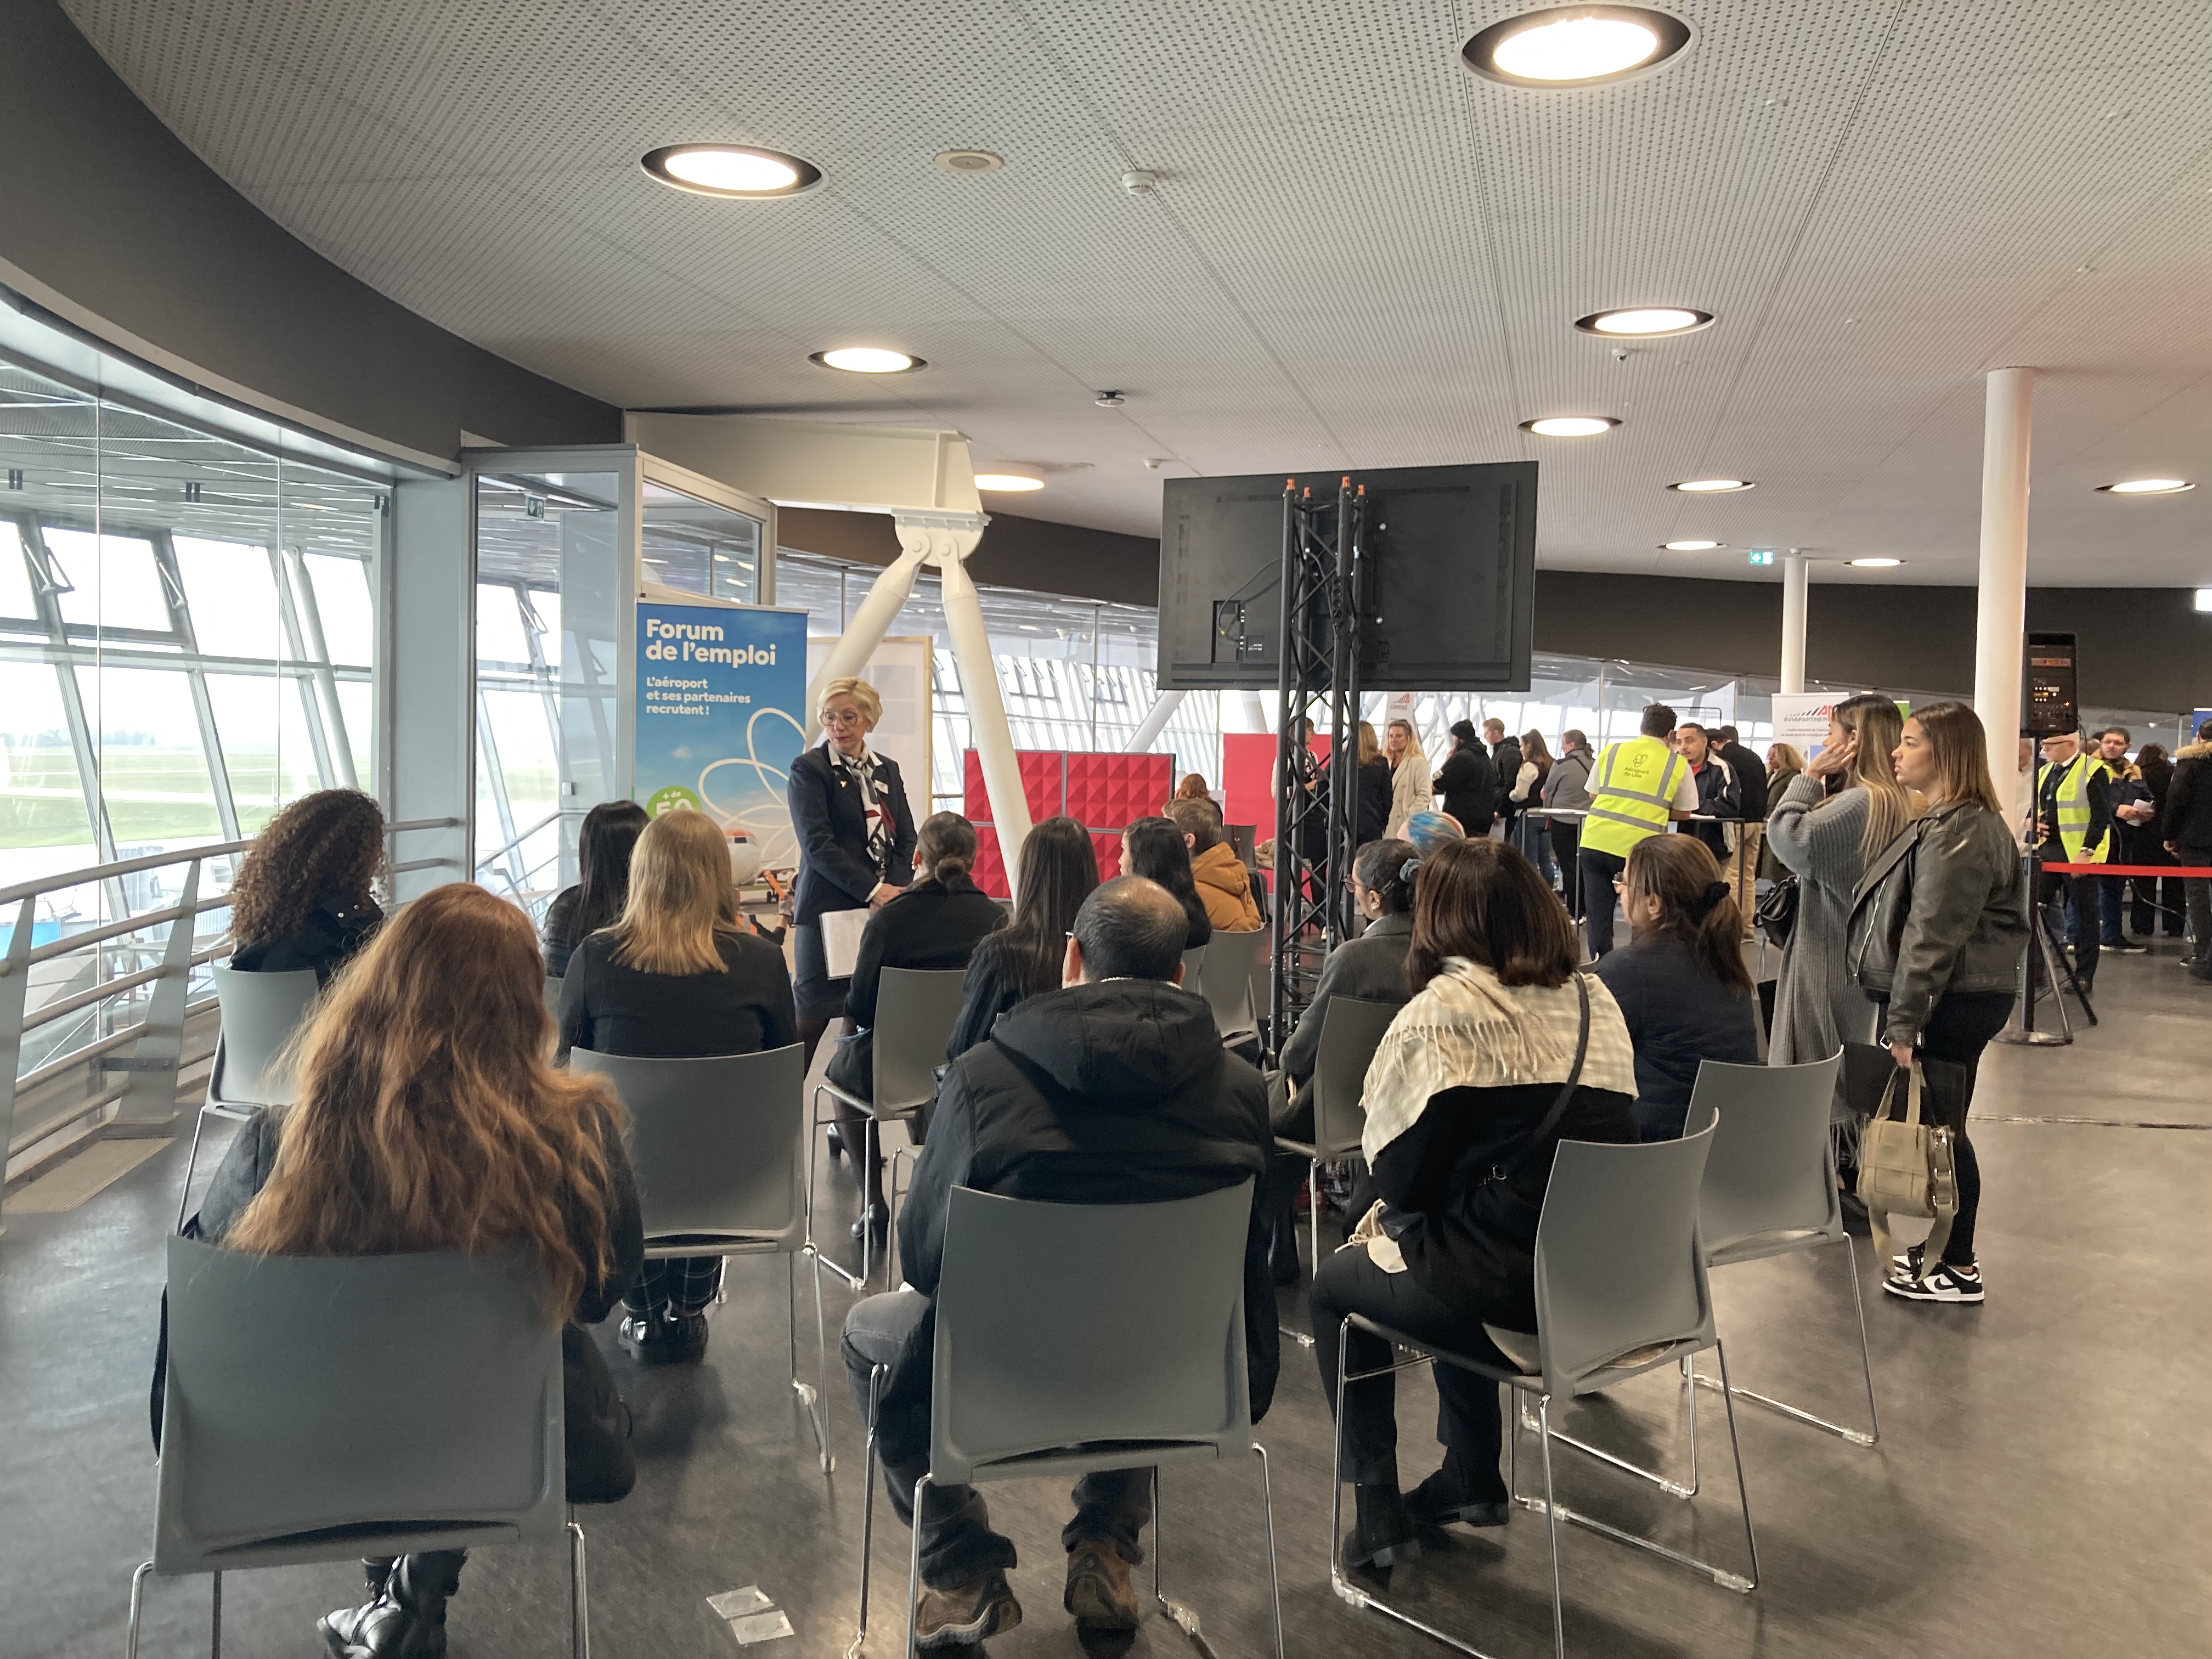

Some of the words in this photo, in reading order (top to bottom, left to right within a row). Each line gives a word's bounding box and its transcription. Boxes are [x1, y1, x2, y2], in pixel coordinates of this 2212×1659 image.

[646, 619, 724, 641] Forum
[646, 640, 678, 661] de
[683, 641, 776, 668] l'emploi
[646, 676, 708, 690] L'aéroport
[646, 690, 660, 700] et
[662, 692, 681, 701] ses
[684, 691, 751, 703] partenaires
[1624, 766, 1649, 775] Aéroport
